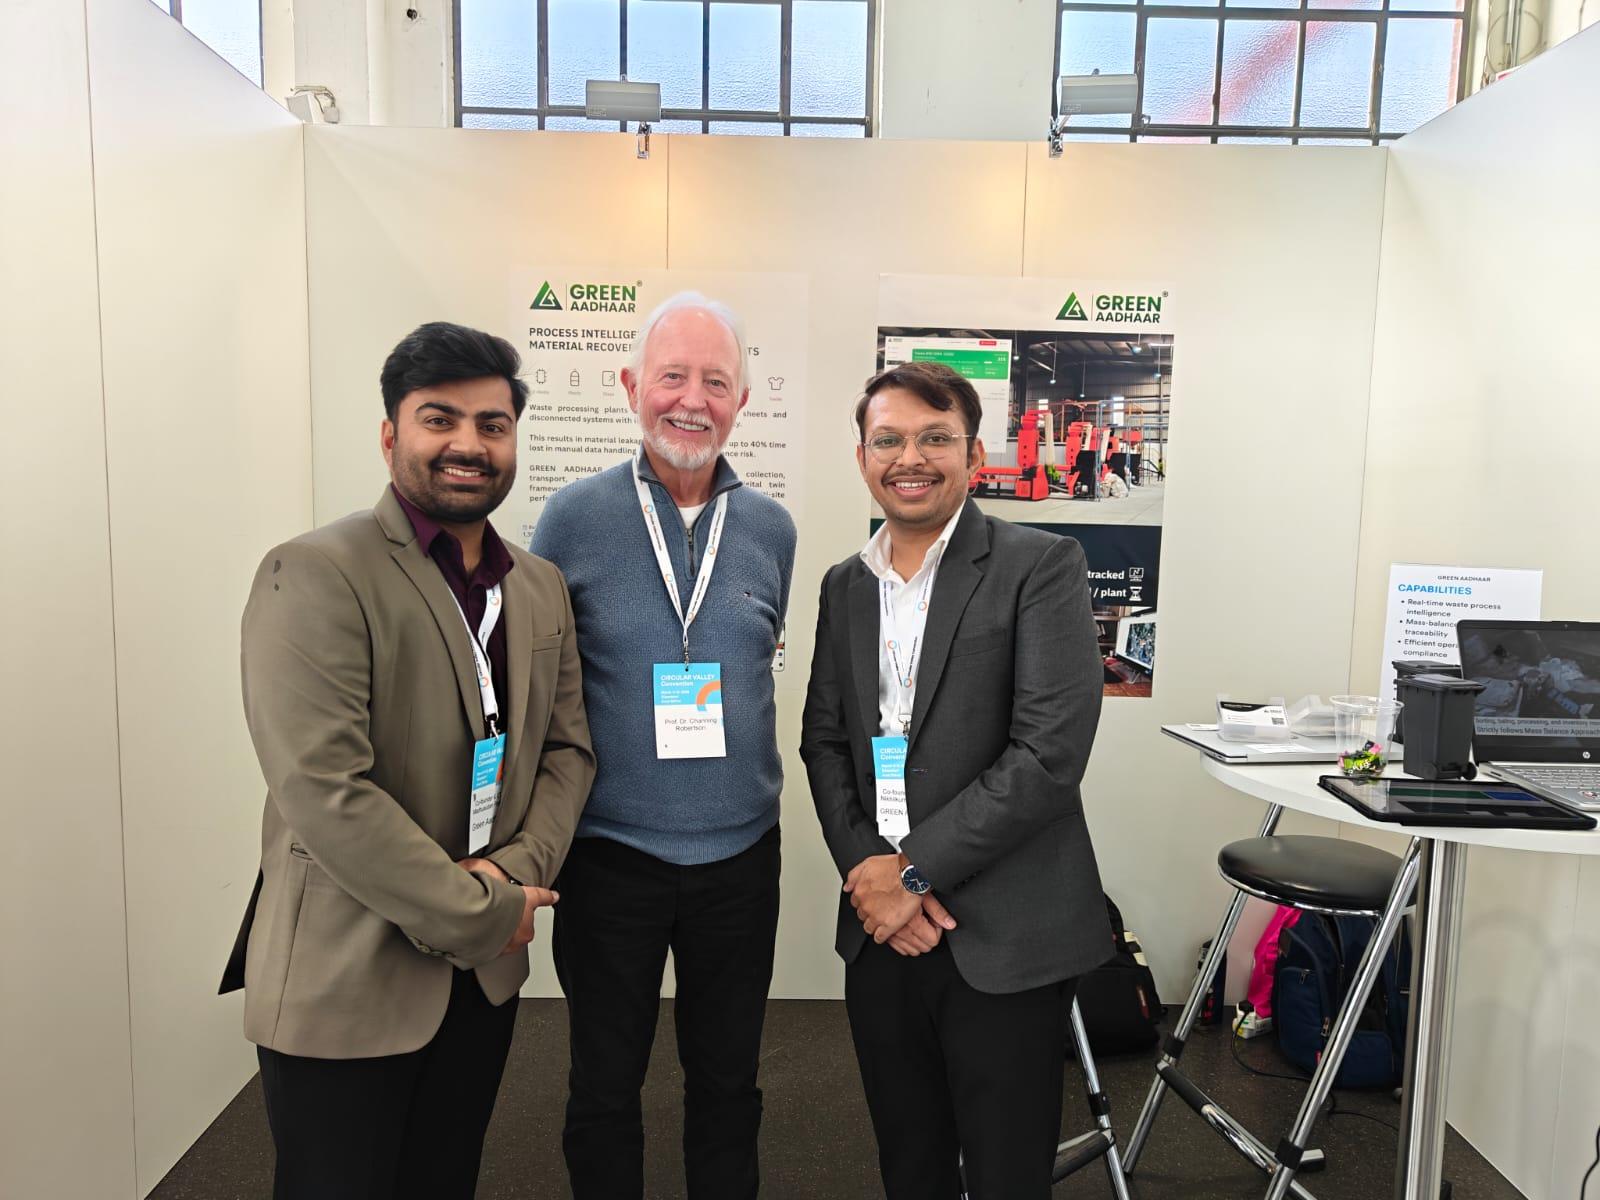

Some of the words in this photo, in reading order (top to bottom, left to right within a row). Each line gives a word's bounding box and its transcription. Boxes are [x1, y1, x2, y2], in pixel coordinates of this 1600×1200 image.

[570, 284, 636, 301] GREEN
[570, 301, 636, 313] AADHAAR
[1096, 295, 1161, 312] GREEN
[1096, 312, 1160, 323] AADHAAR
[529, 327, 578, 338] PROCESS
[581, 329, 639, 339] INTELLIGE
[529, 340, 584, 351] MATERIAL
[557, 405, 599, 413] processing
[743, 410, 768, 418] sheets
[772, 411, 787, 419] and
[529, 414, 581, 422] disconnected
[583, 416, 614, 424] systems
[529, 434, 545, 442] This
[547, 434, 574, 442] results
[584, 435, 617, 443] material
[750, 440, 768, 448] 40%
[769, 441, 787, 449] time
[529, 444, 544, 452] lost
[554, 445, 583, 453] manual
[603, 446, 637, 455] handling
[740, 450, 757, 458] risk.
[746, 471, 786, 479] collection,
[529, 475, 568, 483] transport,
[769, 481, 786, 489] twin
[529, 484, 560, 492] framew
[529, 495, 548, 503] perf
[1088, 570, 1125, 580] tracked
[1100, 587, 1127, 599] plant
[1398, 584, 1472, 595] CAPABILITIES
[1407, 598, 1444, 607] Real-time
[1470, 602, 1502, 610] process
[1406, 609, 1451, 617] intelligence
[1404, 629, 1449, 637] traceability
[1404, 638, 1436, 647] Efficient
[1403, 649, 1448, 658] compliance
